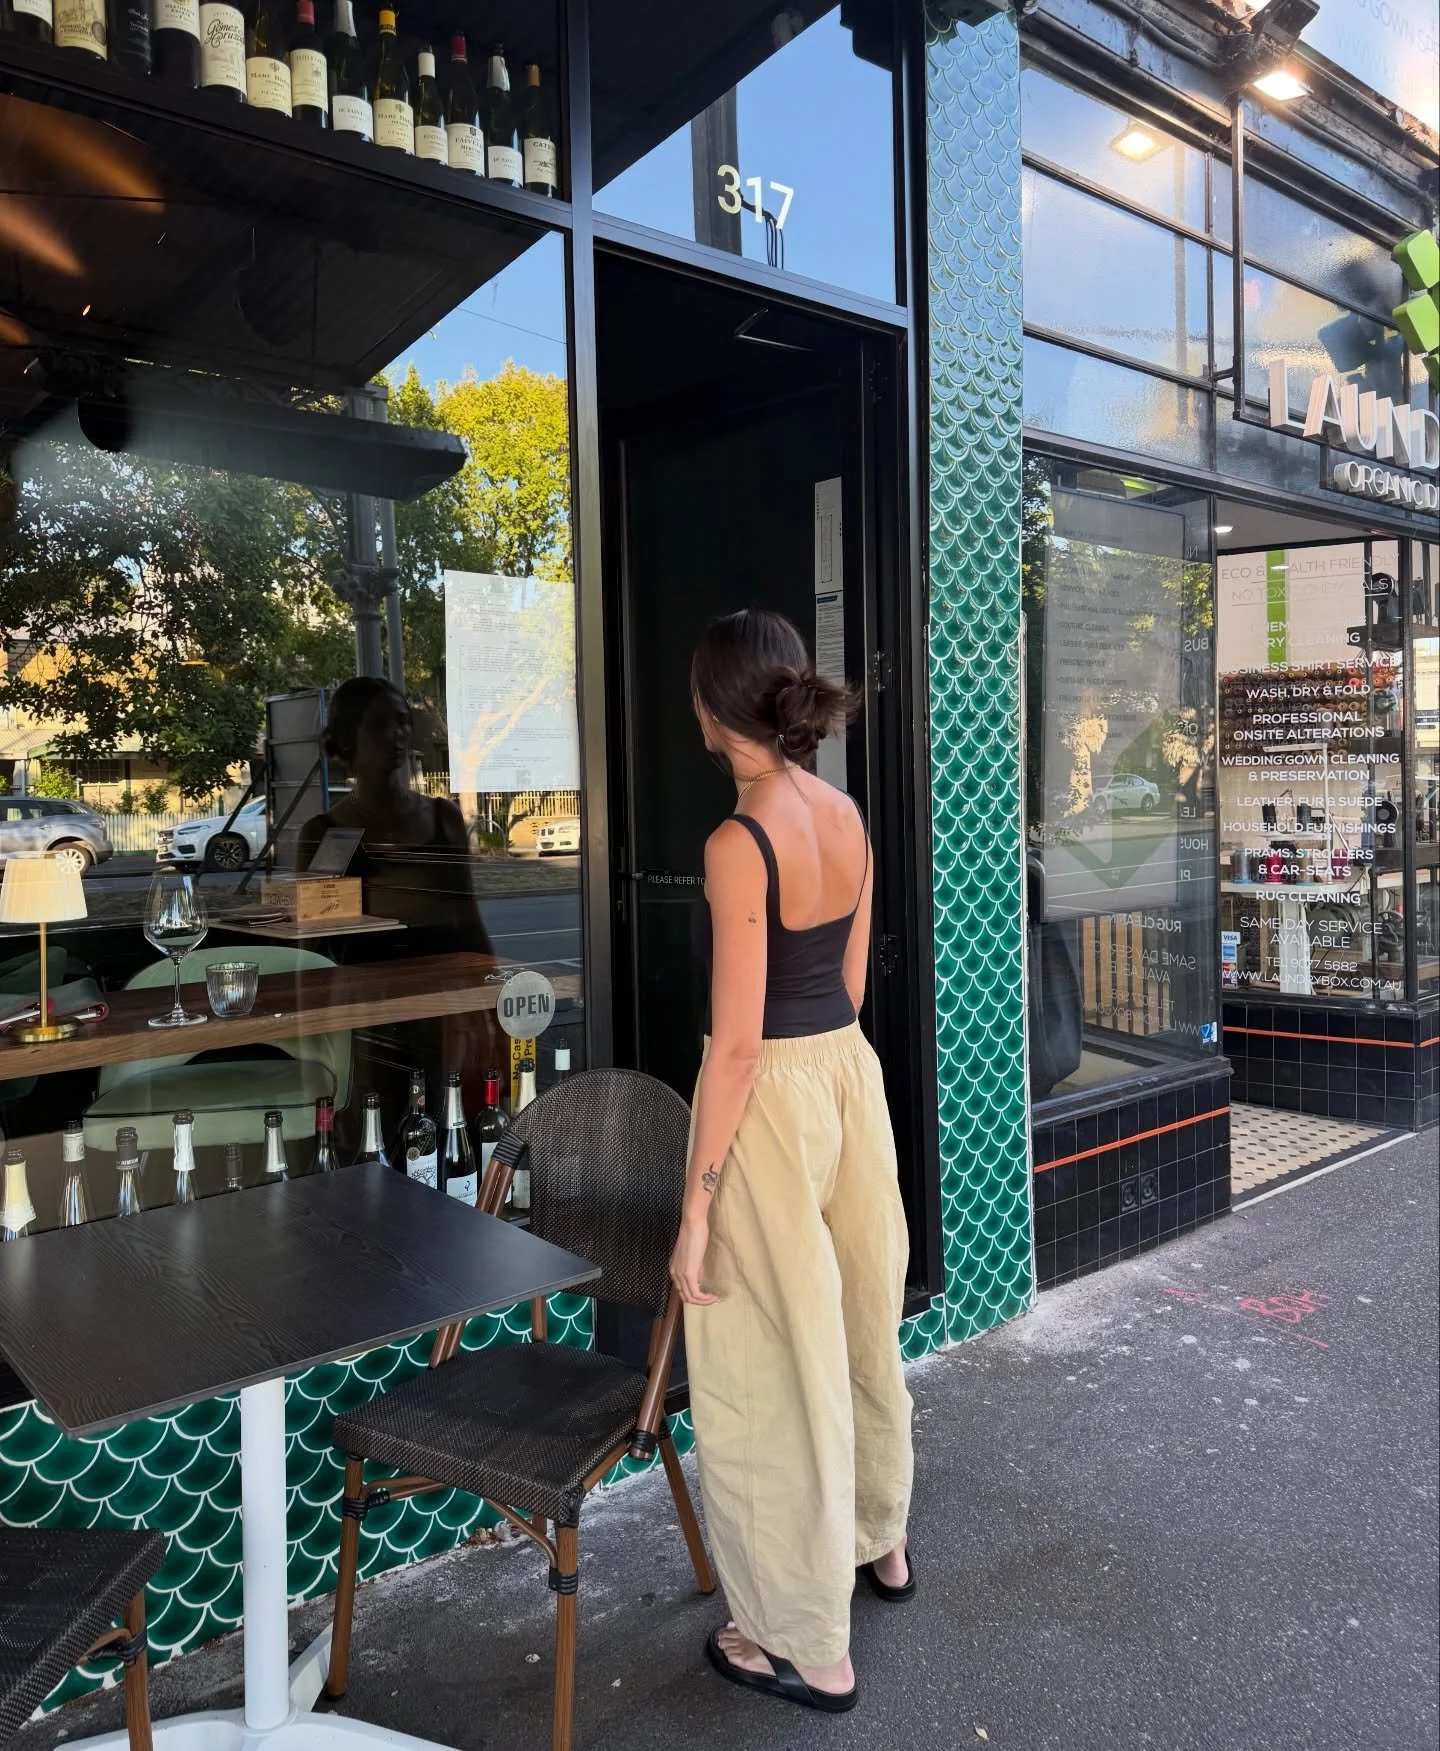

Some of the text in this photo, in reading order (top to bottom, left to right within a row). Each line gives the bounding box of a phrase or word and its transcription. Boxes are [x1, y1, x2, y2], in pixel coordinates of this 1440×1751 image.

[532, 141, 555, 151] CATE
[717, 164, 794, 230] 317
[1333, 460, 1423, 506] ORGANIC
[1221, 553, 1399, 580] ECO & HEALTH FRIENDLY
[1232, 589, 1253, 600] NO
[1291, 658, 1333, 672] SHIRT
[1335, 655, 1397, 669] SERVICE
[1246, 683, 1372, 700] WASH, DRY & FOLD
[1252, 710, 1363, 725] PROFESSIONAL
[1233, 726, 1385, 742] ONSITE ALTERATIONS
[1222, 755, 1283, 767] WEDDING
[1285, 754, 1328, 766] GOWN
[1330, 752, 1400, 765] CLEANING
[1248, 770, 1371, 782] & PRESERVATION
[1236, 796, 1296, 808] LEATHER,
[1298, 797, 1326, 808] FUR
[1337, 796, 1383, 808] SUEDE
[1223, 821, 1397, 835] HOUSEHOLD FURNISHINGS
[1244, 847, 1374, 861] PRAMS, STROLLERS
[1258, 864, 1352, 878] & CAR-SEATS
[648, 875, 673, 884] PLEASE
[674, 876, 696, 885] REFER
[1255, 890, 1362, 906] RUG CLEANING
[1239, 916, 1384, 936] SAME DAY SERVICE
[1223, 934, 1238, 942] VISA
[1269, 935, 1351, 949] AVAILABLE
[1265, 956, 1358, 973] TEL 9077 5682
[1222, 969, 1401, 992] WWW.LAUNDRYBOX.COM.AU
[503, 992, 550, 1018] OPEN
[512, 1038, 521, 1061] Cas
